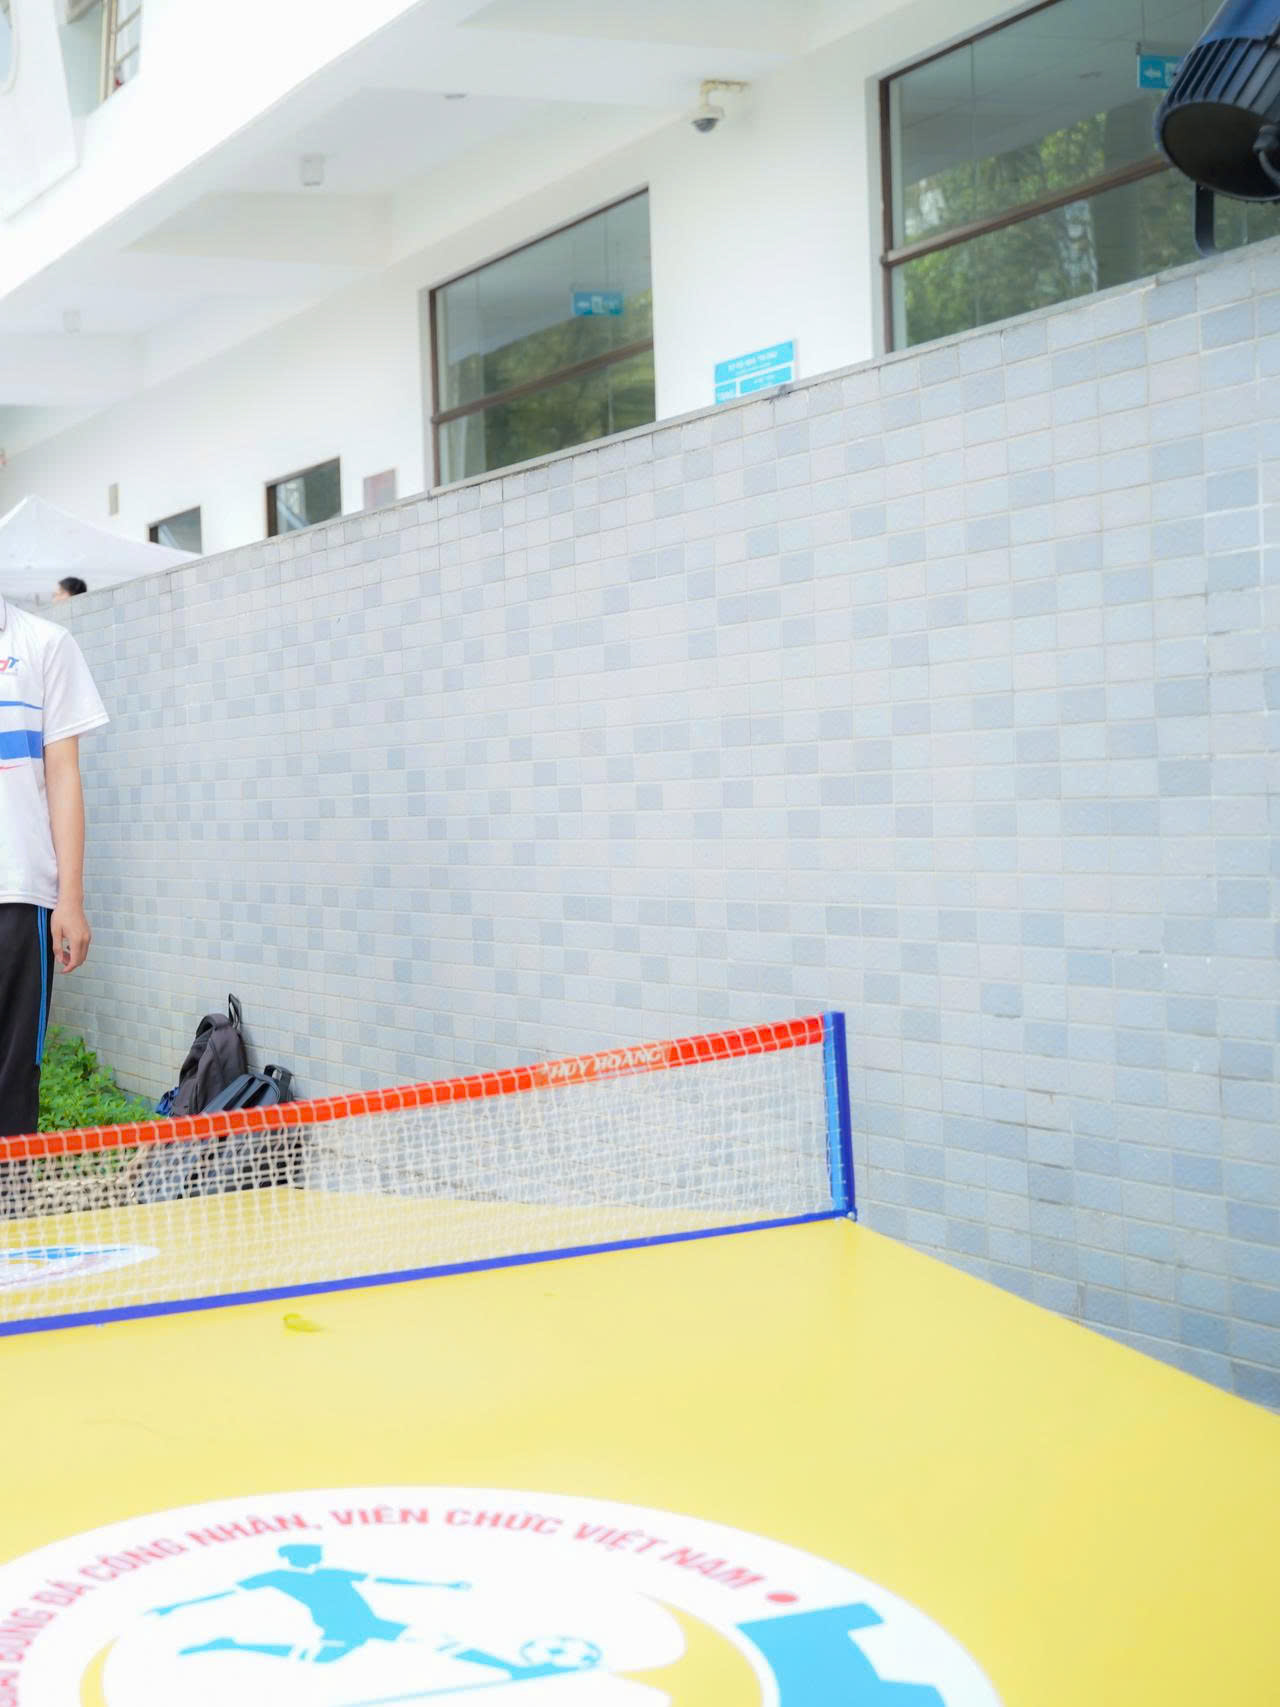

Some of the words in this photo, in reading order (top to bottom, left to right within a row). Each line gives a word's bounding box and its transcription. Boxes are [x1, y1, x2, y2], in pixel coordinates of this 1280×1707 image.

[329, 1504, 429, 1526] VIÊN
[573, 1522, 668, 1554] VIỆT
[658, 1546, 766, 1590] NAM
